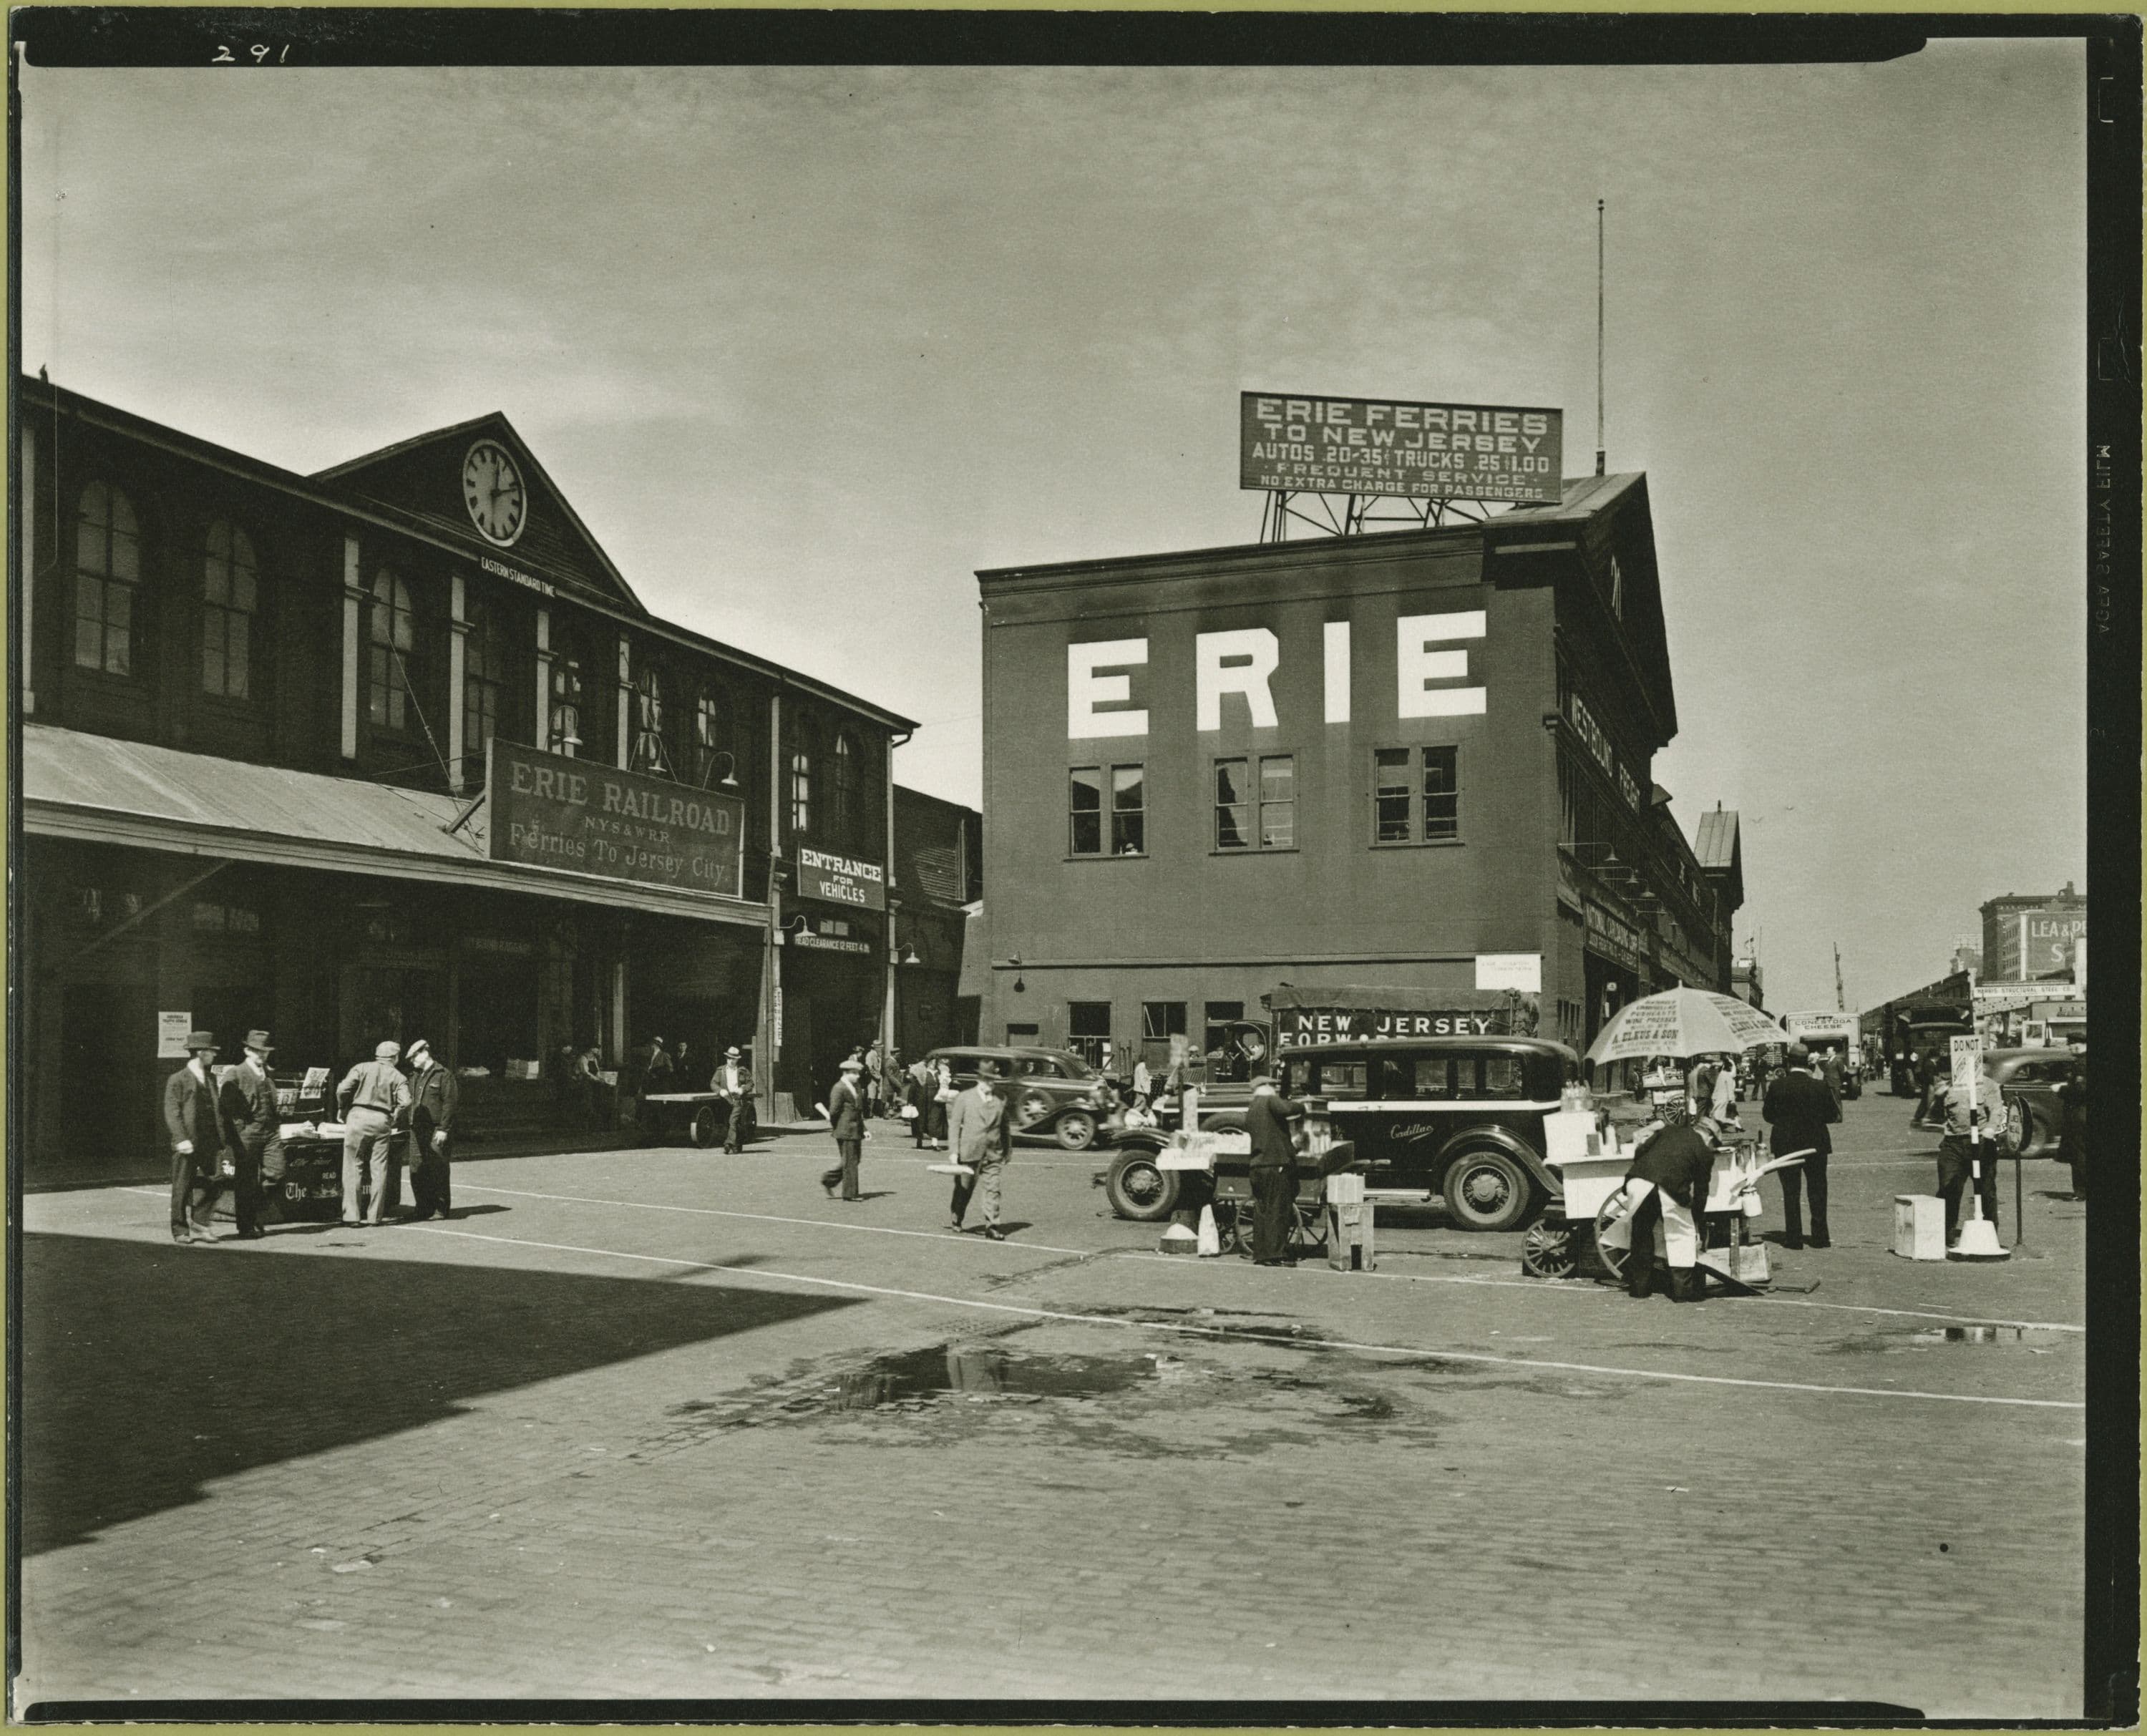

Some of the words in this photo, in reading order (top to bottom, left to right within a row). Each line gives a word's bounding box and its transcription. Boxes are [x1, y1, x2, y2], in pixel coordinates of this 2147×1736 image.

[212, 44, 289, 64] 291
[1257, 398, 1353, 424] ERIE
[1366, 404, 1547, 435] FERRIES
[1264, 423, 1306, 442] TO
[1323, 427, 1395, 447] NEW
[1405, 434, 1541, 453] JERSEY
[1252, 443, 1314, 462] AUTOS
[1394, 450, 1465, 469] TRUCKS
[1276, 463, 1406, 480] FREQUENT
[1422, 470, 1526, 485] SERVICE
[1261, 475, 1279, 487] NO
[1284, 476, 1336, 489] EXTRA
[1342, 479, 1406, 492] CHARGE
[1412, 483, 1438, 494] FOR
[1445, 484, 1543, 499] PASSENGERS
[481, 556, 509, 577] EASTERN
[509, 570, 541, 591] STANDARD
[541, 578, 555, 598] TIME
[1067, 610, 1487, 739] ERIE
[510, 761, 589, 806] ERIE
[602, 781, 731, 836] RAILROAD
[510, 822, 586, 858] Ferries
[594, 839, 618, 864] To
[625, 844, 684, 879] Jersey
[801, 848, 882, 882] ENTRANCE
[832, 874, 854, 886] FOR
[819, 880, 865, 903] VEHICLES
[2032, 920, 2058, 937] LEA
[2061, 924, 2069, 937] &
[794, 937, 809, 946] HEAD
[809, 937, 839, 950] CLEARANCE
[846, 942, 858, 952] FEET
[1298, 1015, 1352, 1031] NEW
[1377, 1017, 1490, 1035] JERSEY
[1660, 1029, 1679, 1039] SON
[1954, 1040, 1964, 1052] DO
[1965, 1039, 1979, 1051] NOT
[1391, 1123, 1435, 1141] Cadillac
[322, 1171, 337, 1180] READ
[285, 1181, 307, 1201] The
